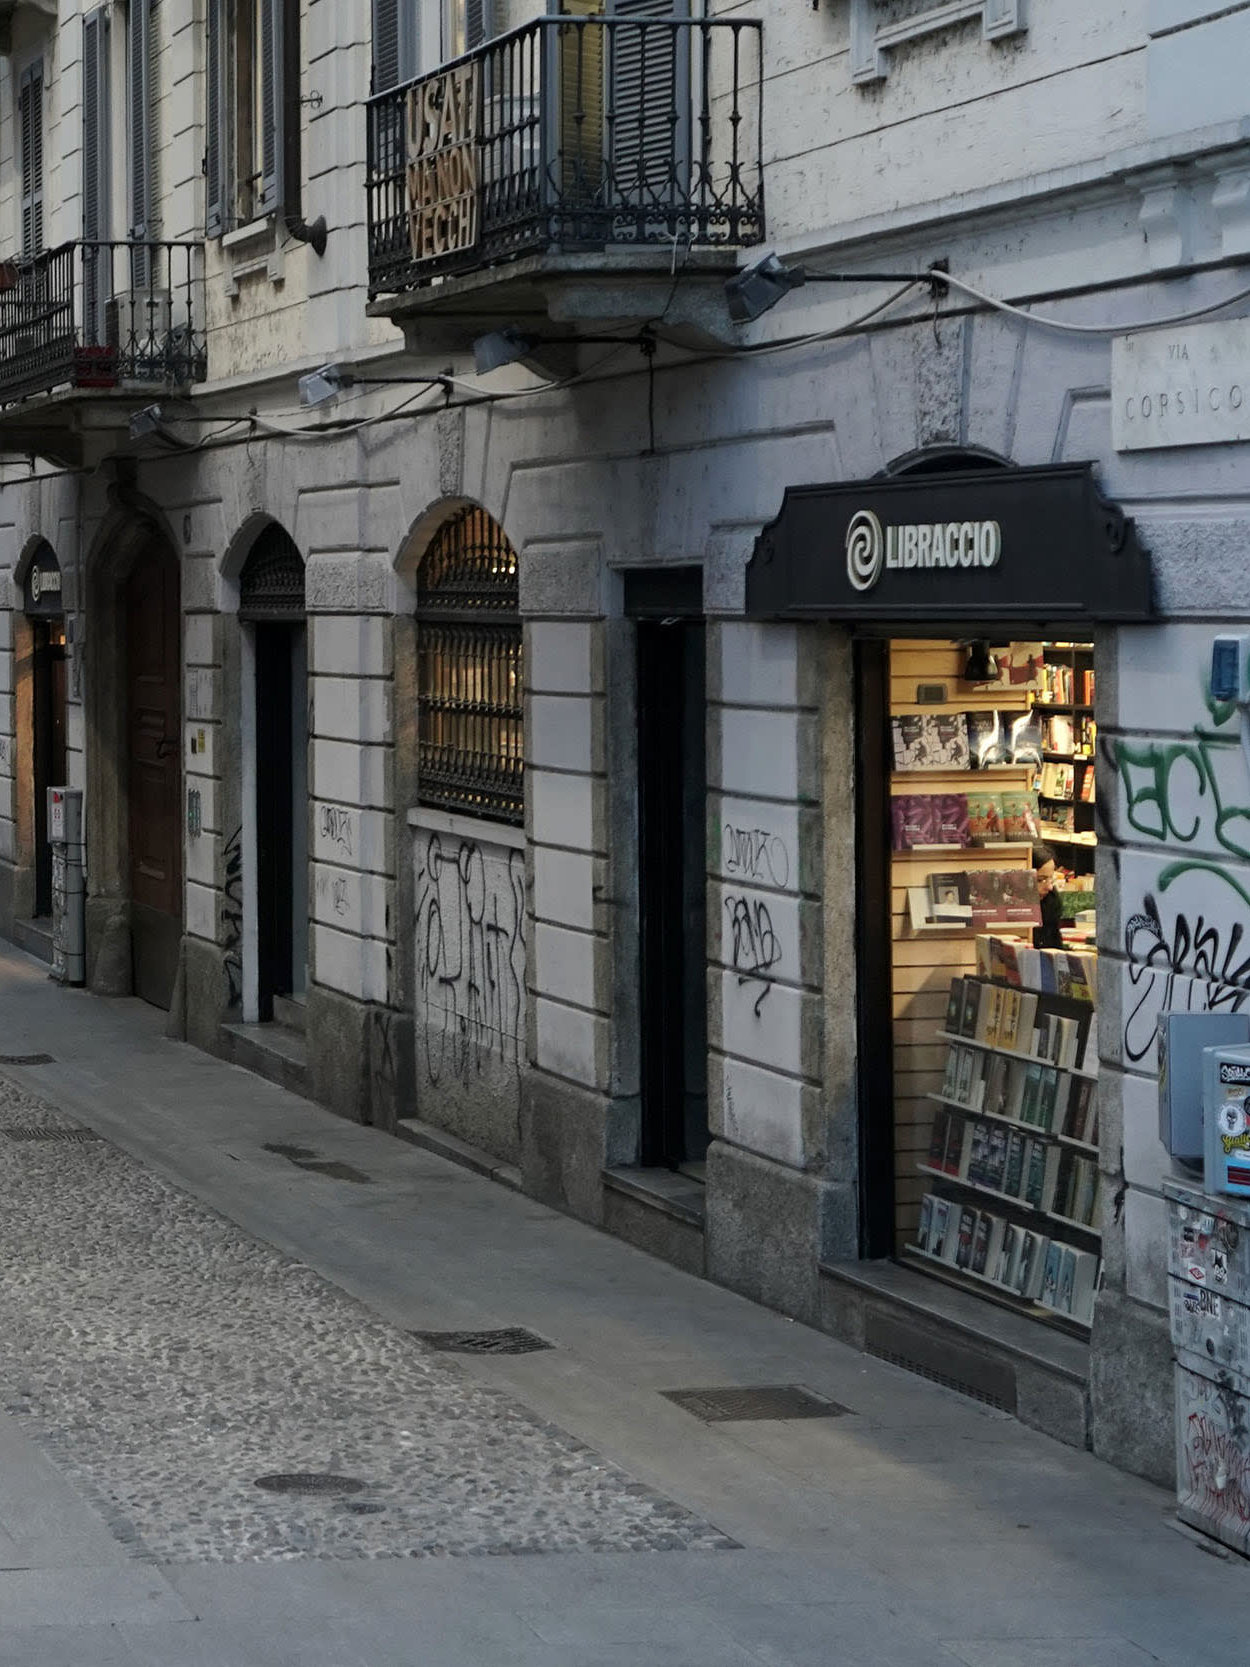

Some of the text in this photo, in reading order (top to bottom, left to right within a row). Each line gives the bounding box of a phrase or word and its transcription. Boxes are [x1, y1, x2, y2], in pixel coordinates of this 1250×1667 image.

[406, 60, 479, 160] USATI
[406, 143, 477, 212] MA NON
[409, 194, 477, 261] VECCHI
[1167, 343, 1190, 361] VIA
[1125, 384, 1244, 421] CORSICO
[886, 520, 1001, 569] LIBRACCIO
